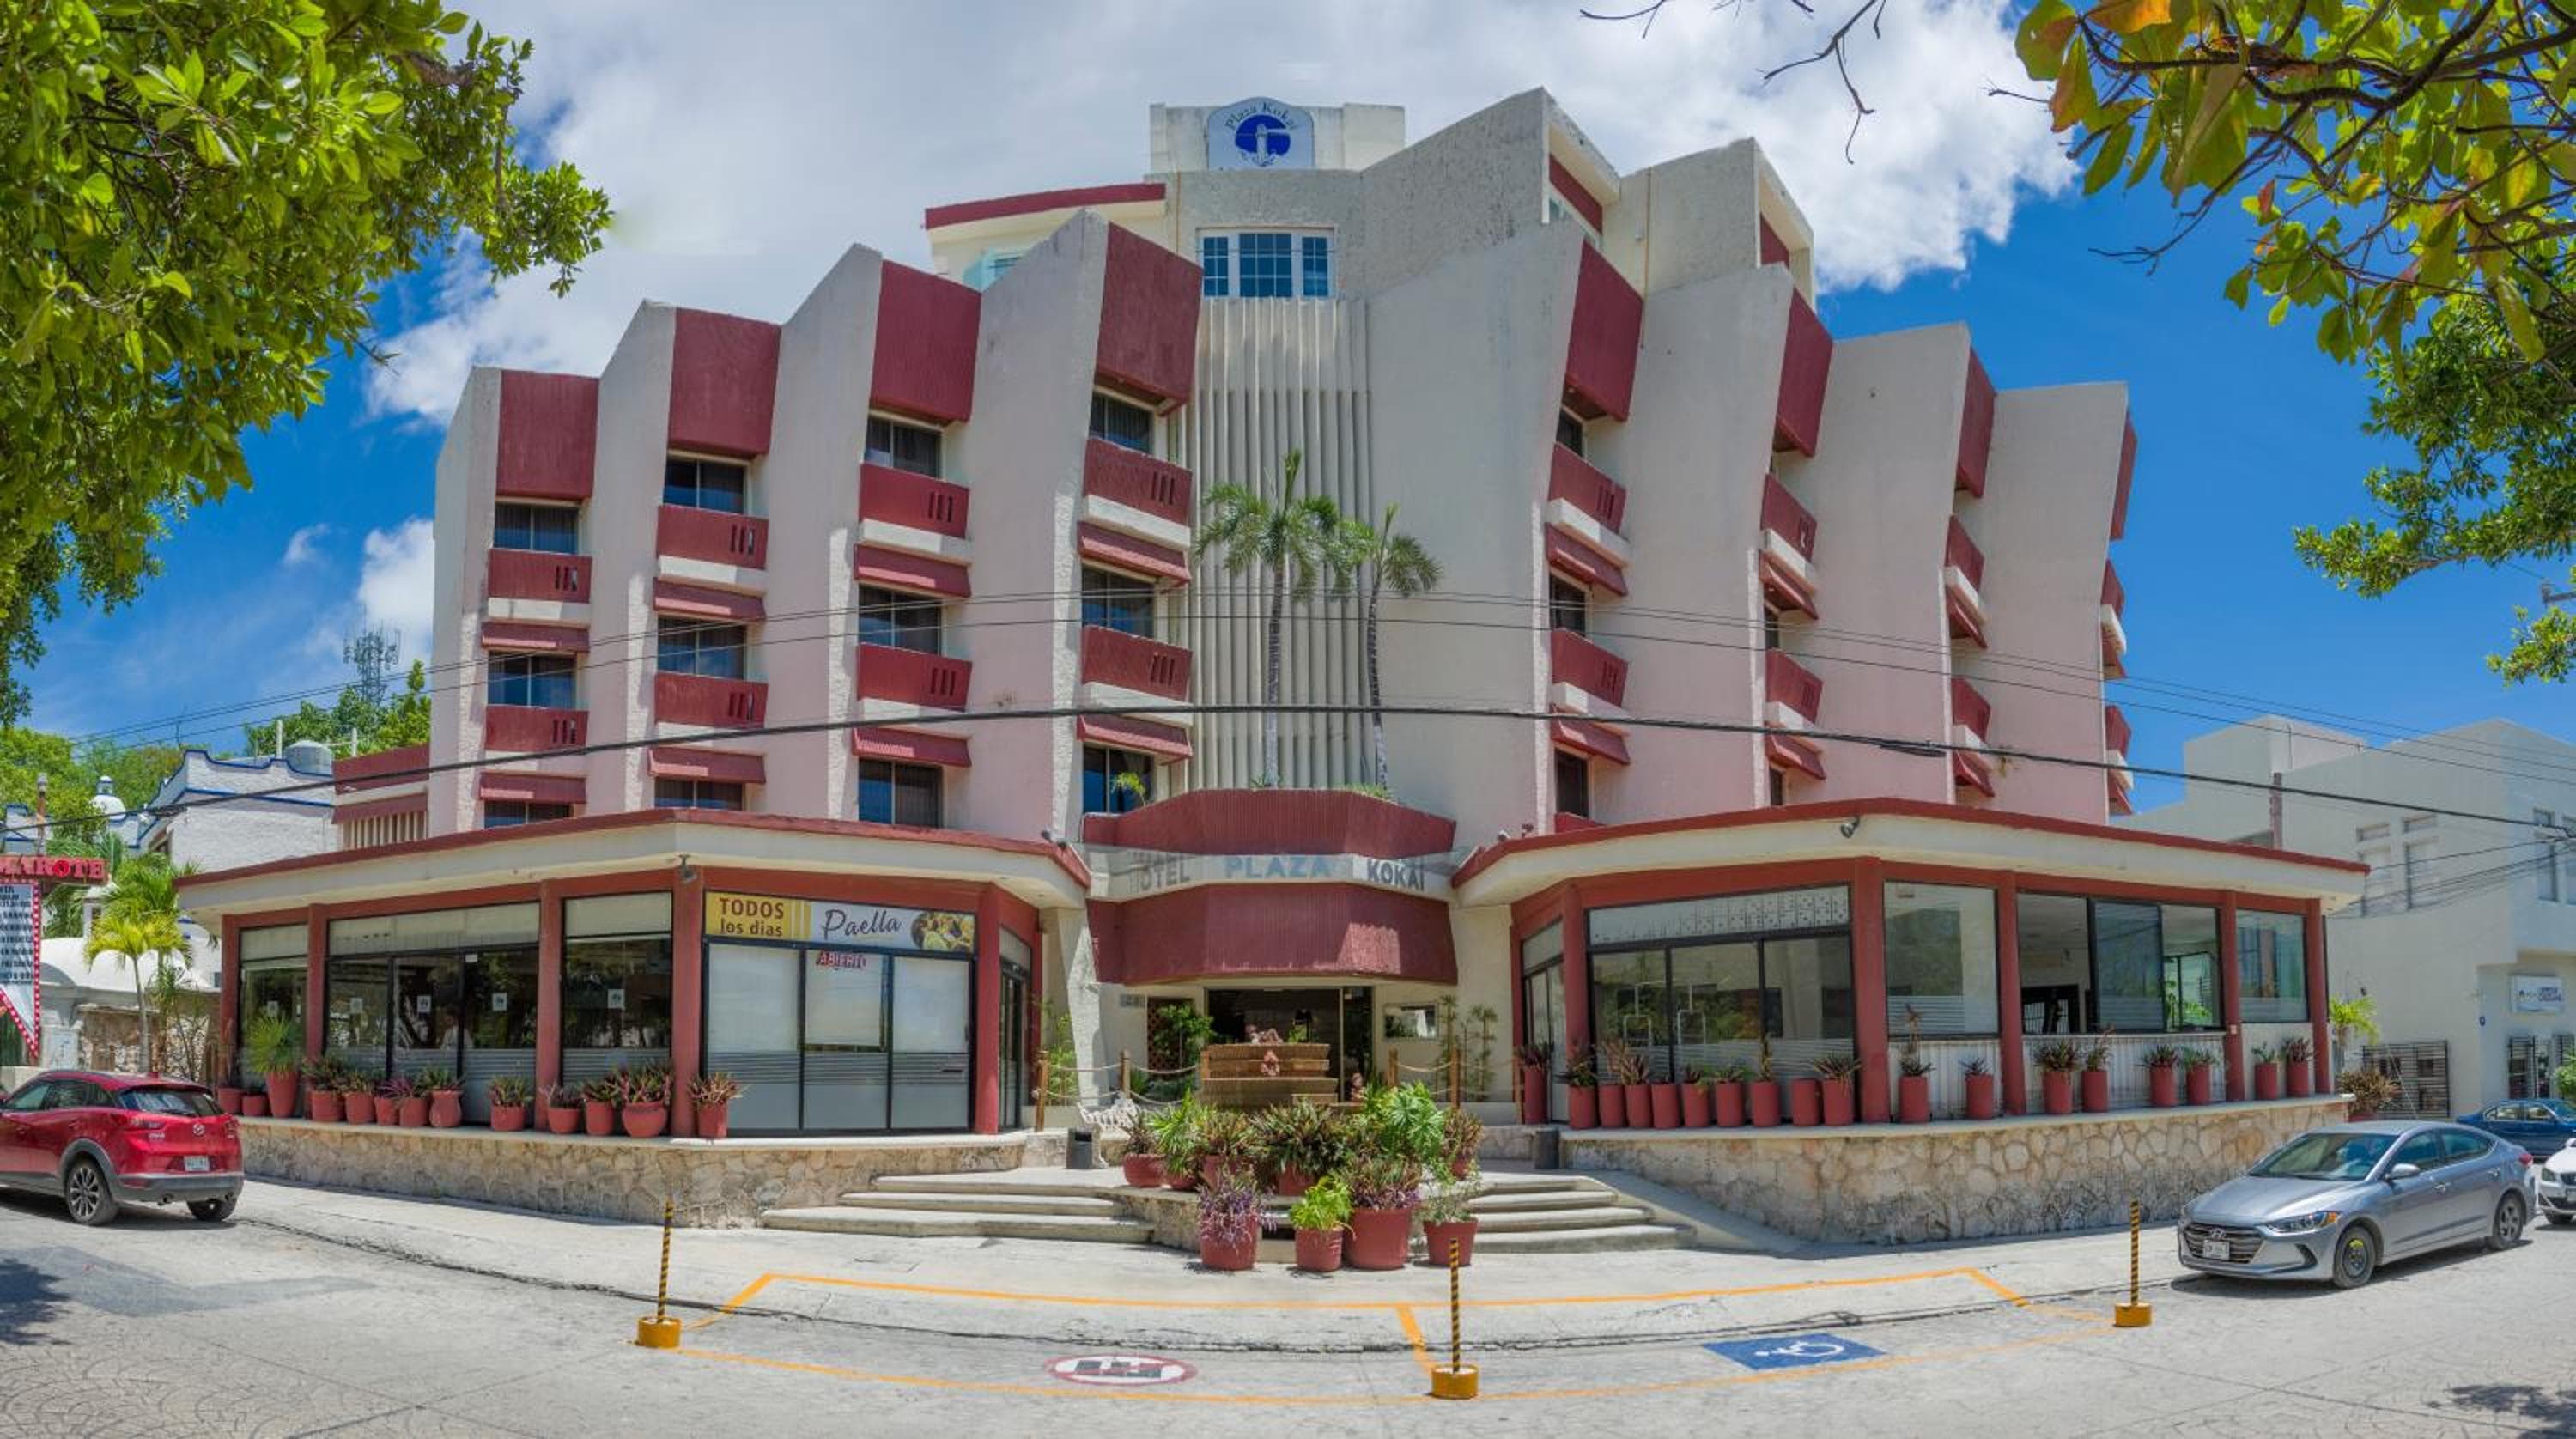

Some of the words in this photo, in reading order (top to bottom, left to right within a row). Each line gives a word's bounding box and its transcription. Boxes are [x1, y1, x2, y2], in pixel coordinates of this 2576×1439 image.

[1224, 105, 1257, 130] Plaza
[1224, 857, 1329, 879] PLAZA
[1367, 859, 1425, 891] KOKAI
[720, 898, 784, 920] TODOS
[720, 919, 744, 935] los
[822, 908, 902, 940] Paella
[816, 950, 866, 968] ABIERTO
